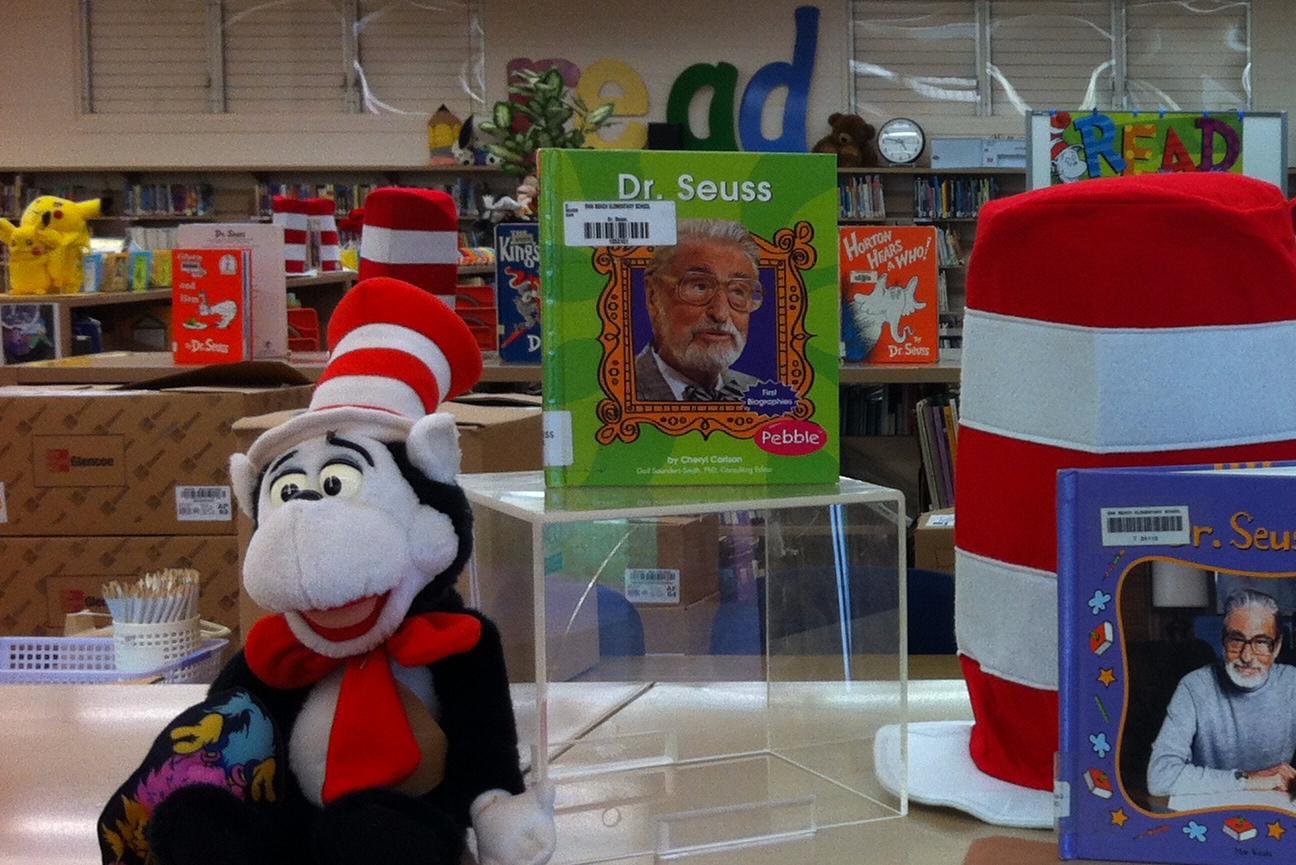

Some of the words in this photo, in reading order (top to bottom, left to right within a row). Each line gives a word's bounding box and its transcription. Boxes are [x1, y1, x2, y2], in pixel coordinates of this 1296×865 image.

[1074, 113, 1243, 178] READ
[618, 173, 662, 200] Dr.
[678, 173, 773, 201] Seuss
[843, 230, 892, 261] HORTON
[866, 239, 904, 270] HEARS
[895, 237, 932, 269] WHO!
[888, 344, 903, 357] Dr.
[905, 343, 930, 356] Seuss
[747, 398, 793, 406] Biographies
[762, 389, 777, 397] First
[762, 431, 820, 445] Pebble
[667, 456, 678, 465] by
[681, 455, 709, 465] Cheryl
[711, 455, 743, 464] Carlson
